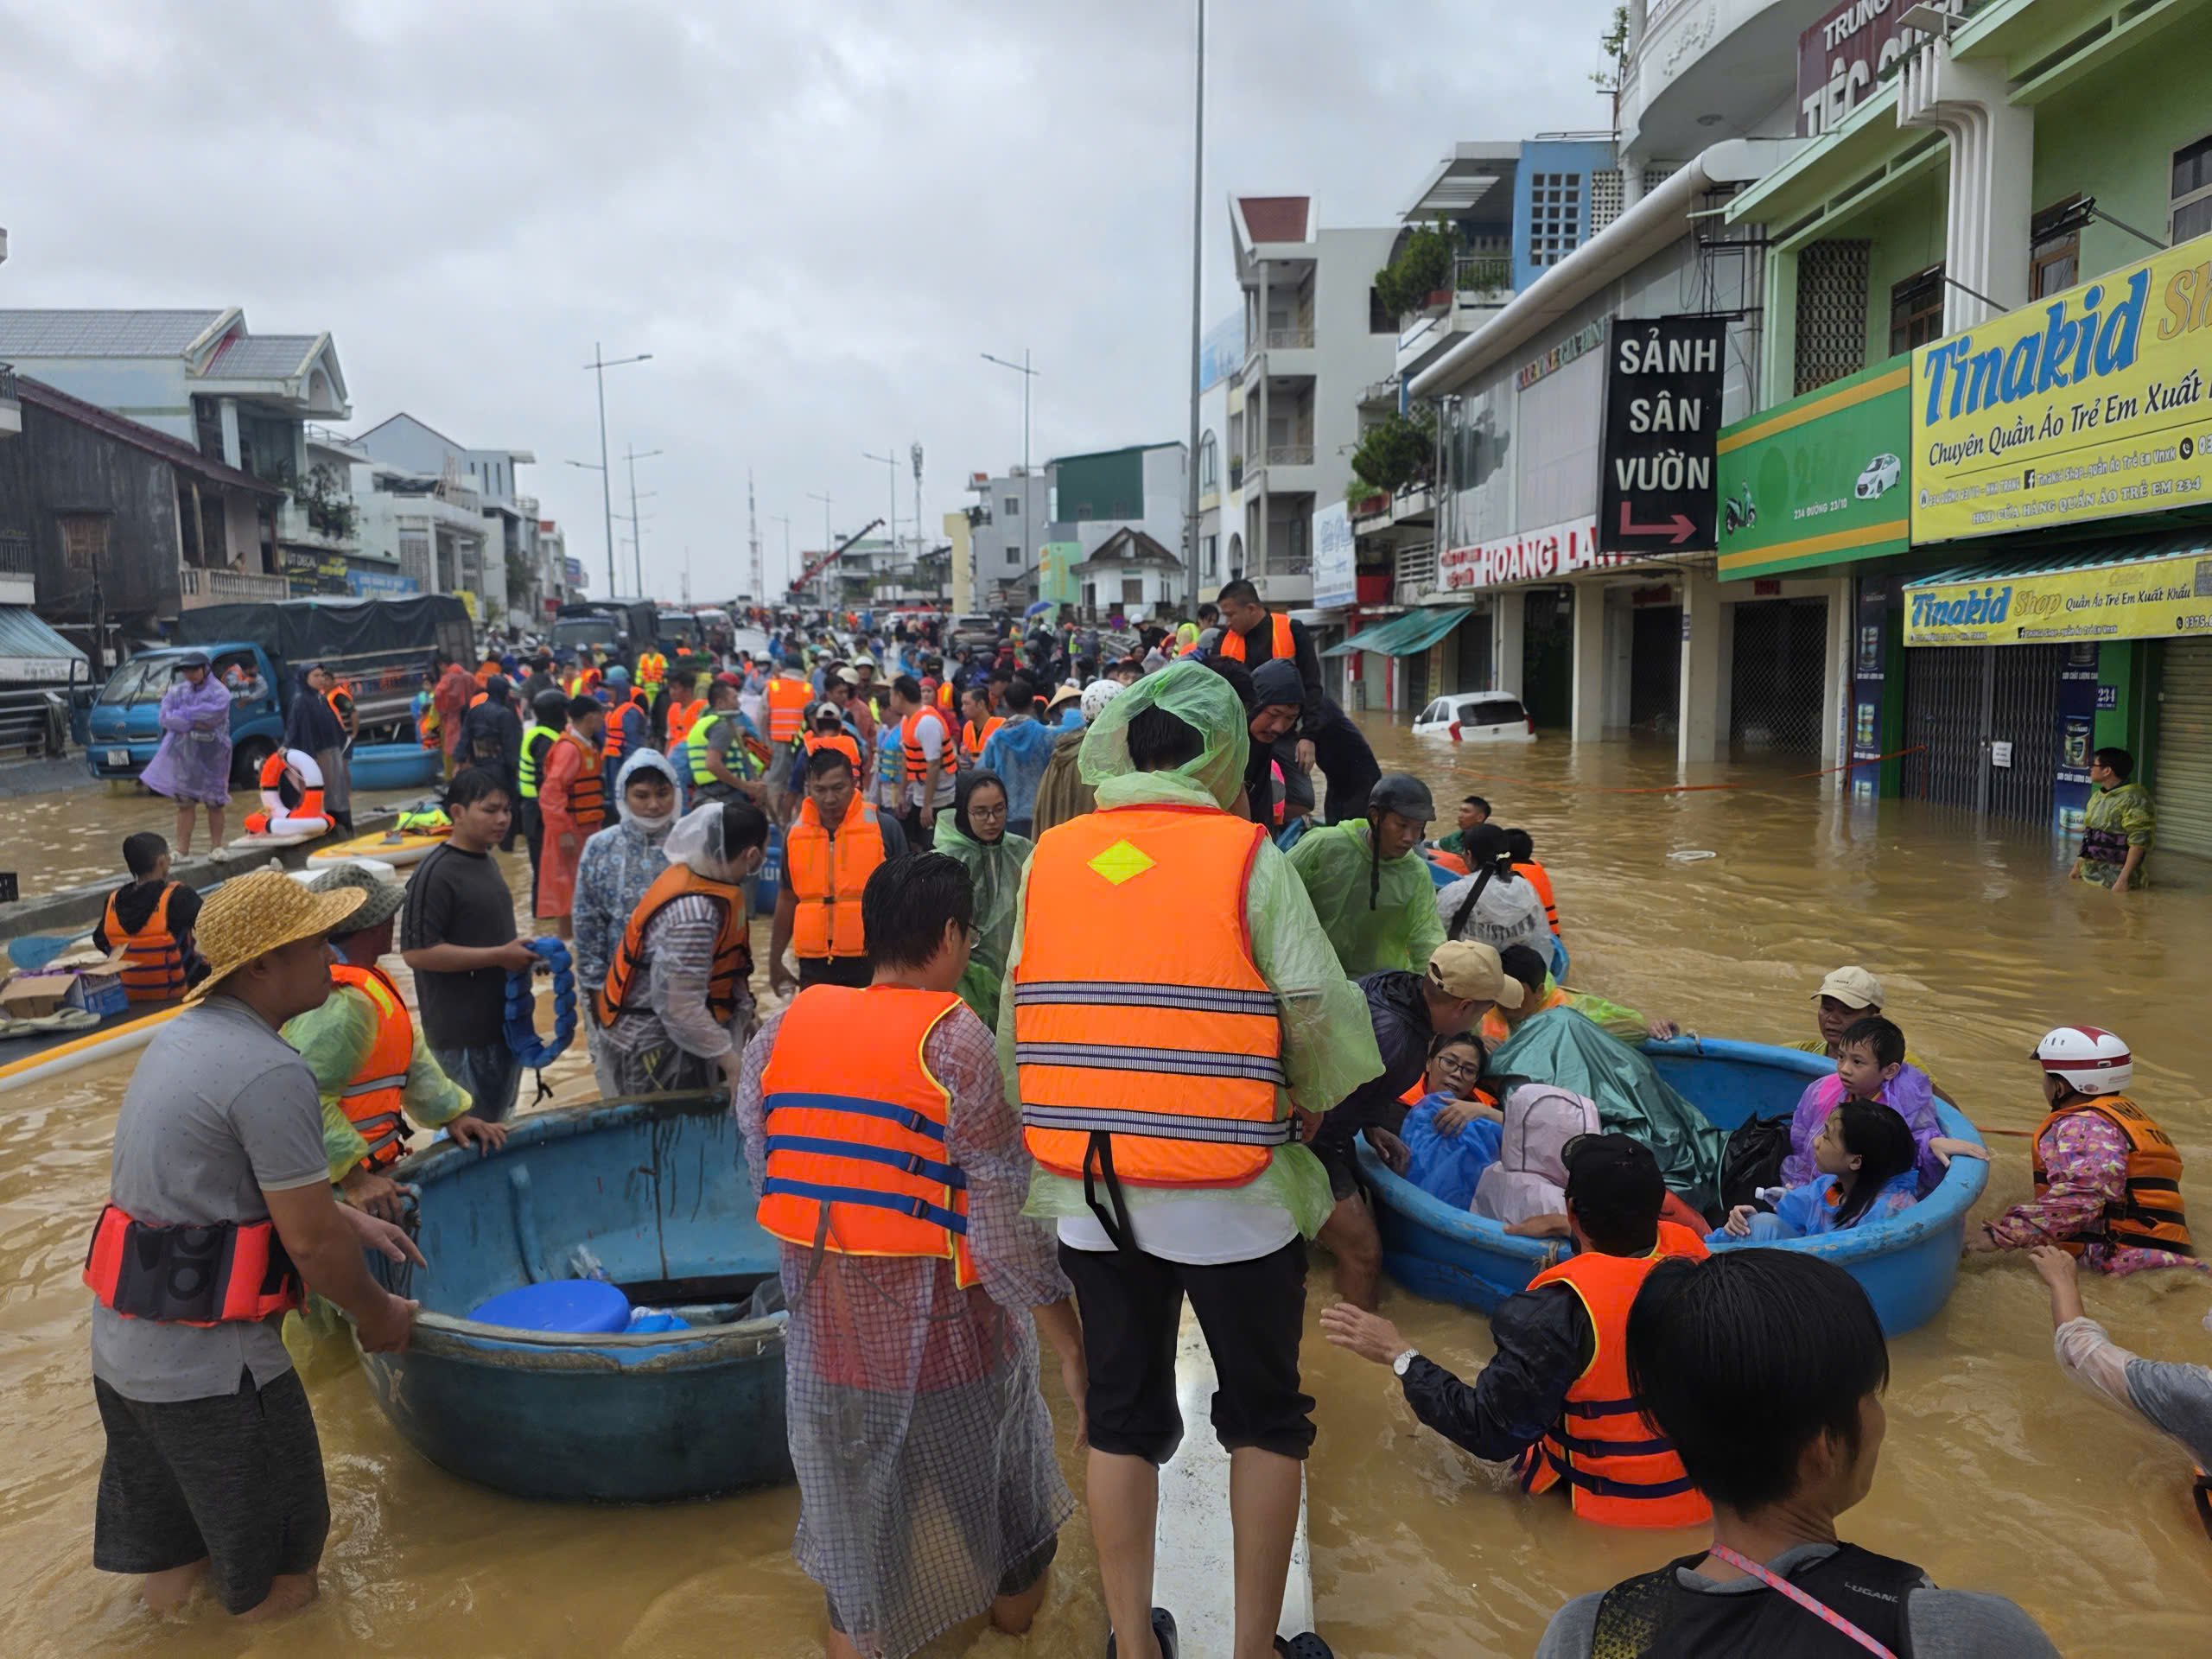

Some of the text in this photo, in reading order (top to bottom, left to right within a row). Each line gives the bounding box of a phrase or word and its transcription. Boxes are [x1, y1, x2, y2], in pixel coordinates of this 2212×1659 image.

[1619, 327, 1717, 374] SẢNH
[1924, 267, 2152, 427] Tinakid
[1630, 390, 1701, 433] SÂN
[1929, 434, 1984, 467] Chuyên
[1989, 416, 2034, 456] Quần
[2038, 405, 2064, 441] Áo
[2071, 397, 2101, 433] Trẻ
[2105, 395, 2138, 423] Em
[2145, 368, 2202, 415] Xuất
[1615, 448, 1710, 491] VƯỜN
[1794, 509, 1805, 520] 234
[1830, 498, 1847, 512] 23/10
[2023, 498, 2055, 517] HÀNG
[2152, 480, 2172, 495] EM
[2176, 476, 2201, 493] 234
[1482, 536, 1559, 585] HOÀNG
[1911, 587, 2012, 628] Tinakid
[2013, 590, 2062, 620] Shop
[2121, 591, 2136, 605] Em
[2097, 688, 2115, 702] 234
